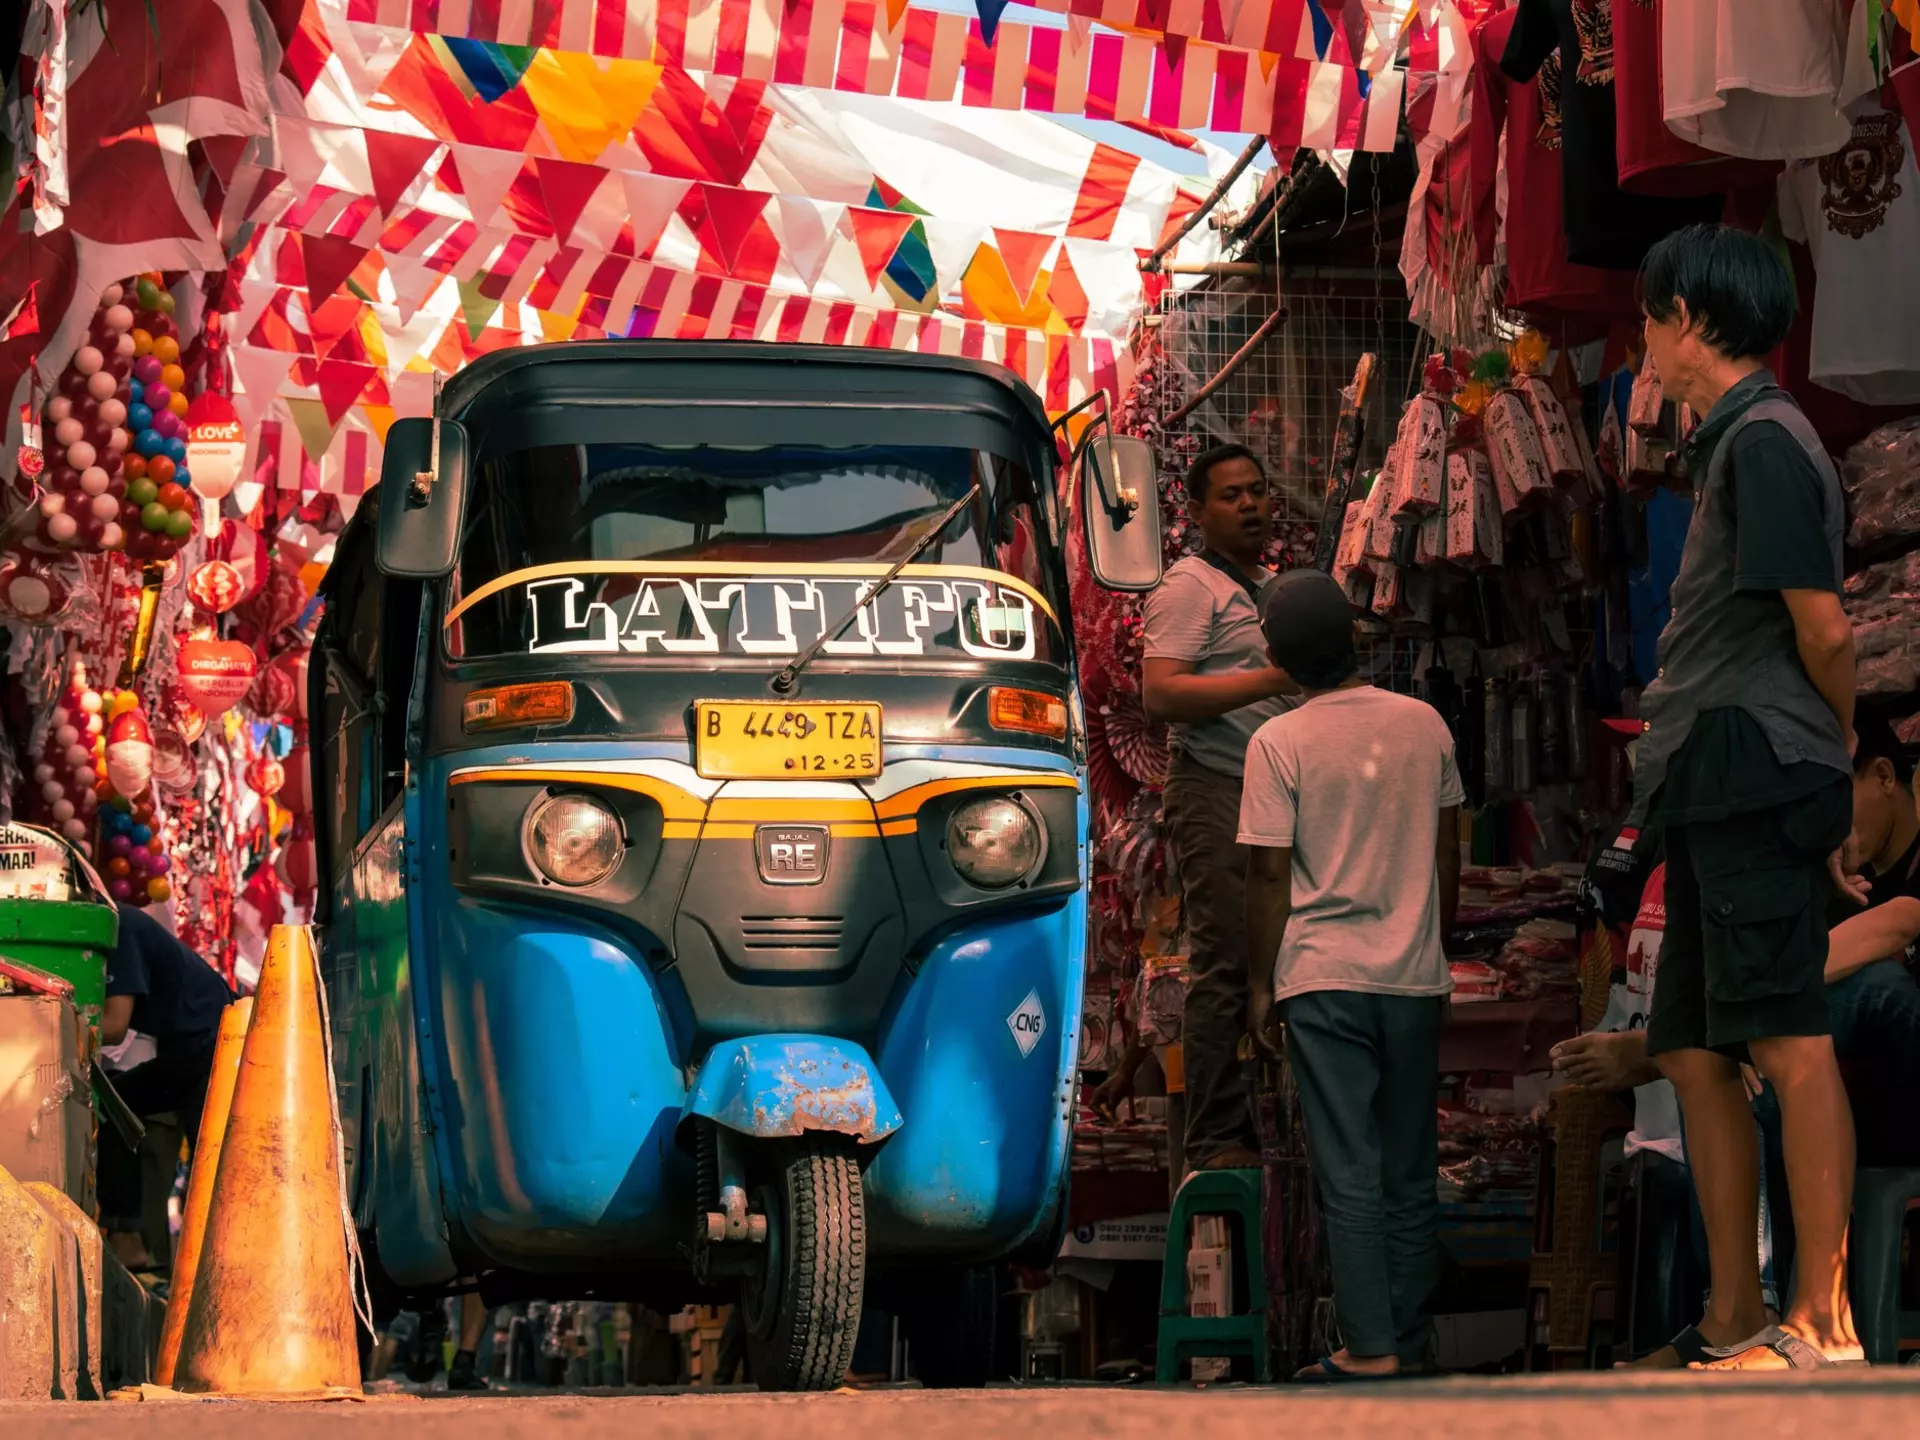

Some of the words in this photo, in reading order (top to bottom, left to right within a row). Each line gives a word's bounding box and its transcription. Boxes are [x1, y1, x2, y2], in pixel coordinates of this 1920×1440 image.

[196, 426, 233, 440] LOVE
[527, 577, 1036, 660] LATIFU
[707, 710, 721, 737] B
[743, 711, 808, 739] 4449
[825, 711, 875, 739] TZA
[777, 833, 809, 842] BAJAJ
[769, 843, 817, 871] RE
[1016, 1012, 1041, 1034] CNG
